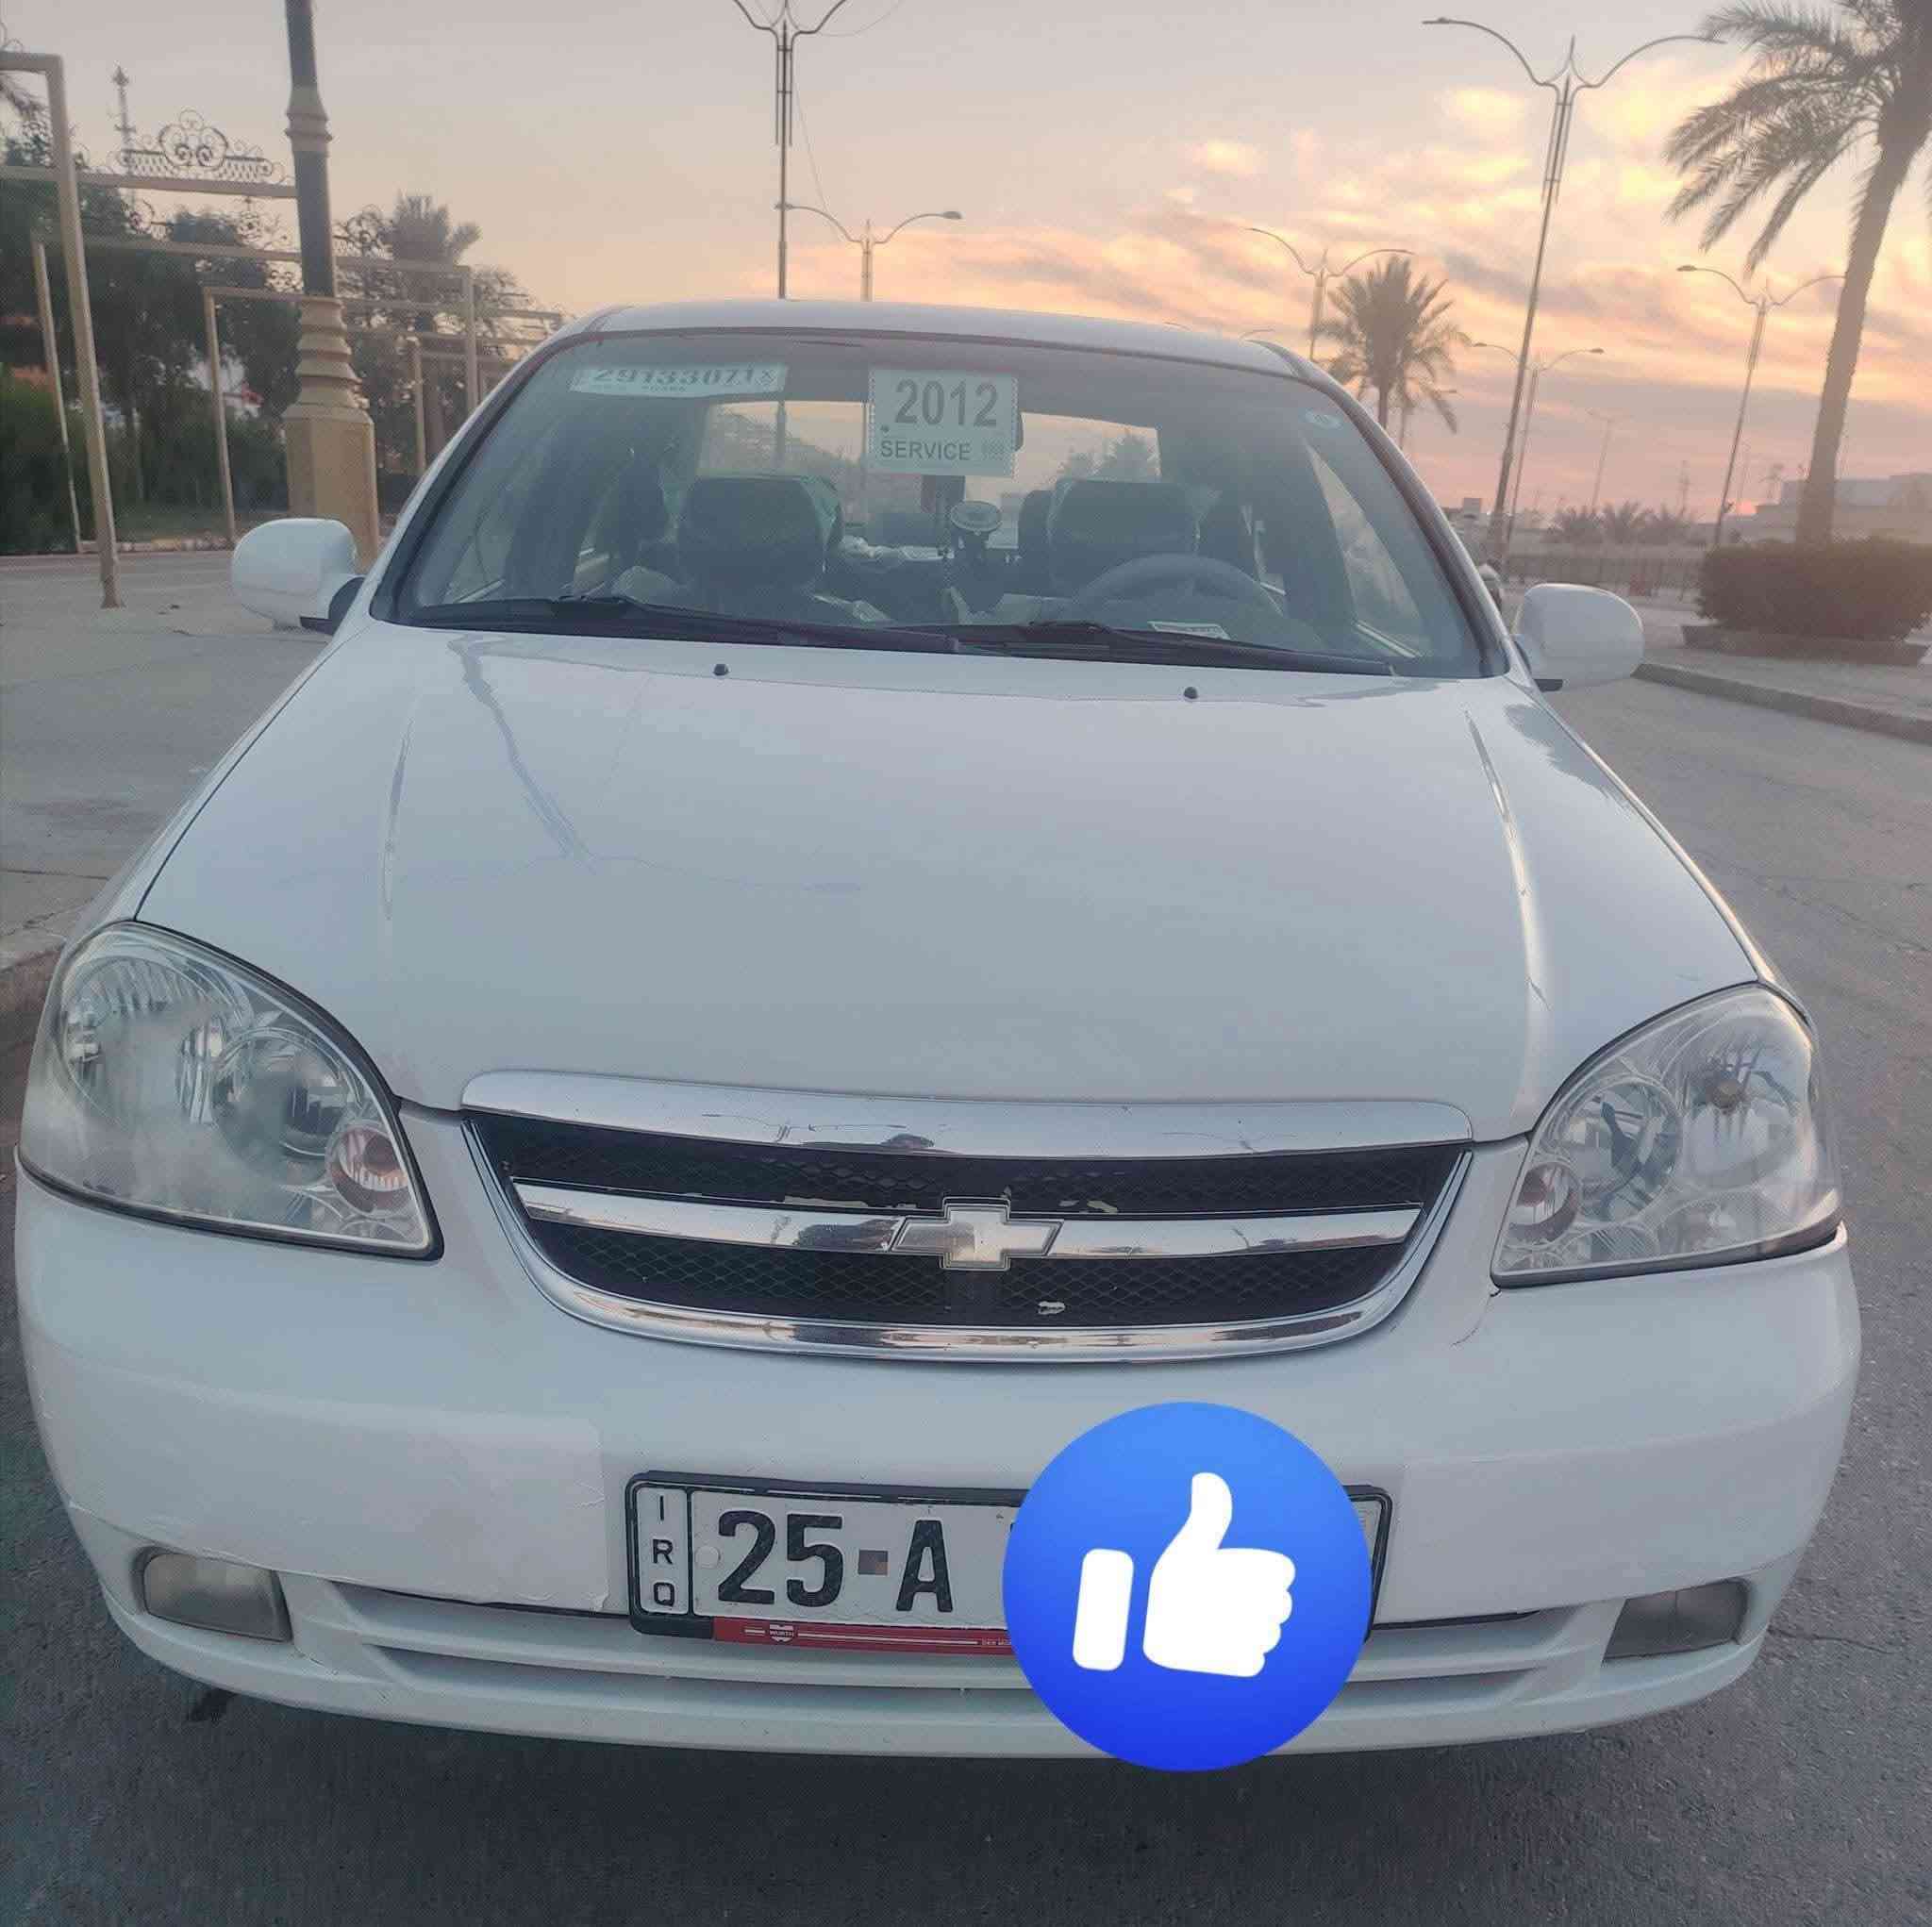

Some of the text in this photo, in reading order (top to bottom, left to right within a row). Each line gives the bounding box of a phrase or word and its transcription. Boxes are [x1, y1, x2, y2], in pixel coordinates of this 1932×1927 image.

[894, 378, 998, 427] 2012
[880, 440, 972, 460] SERVICE
[718, 1510, 954, 1612] 25 A
